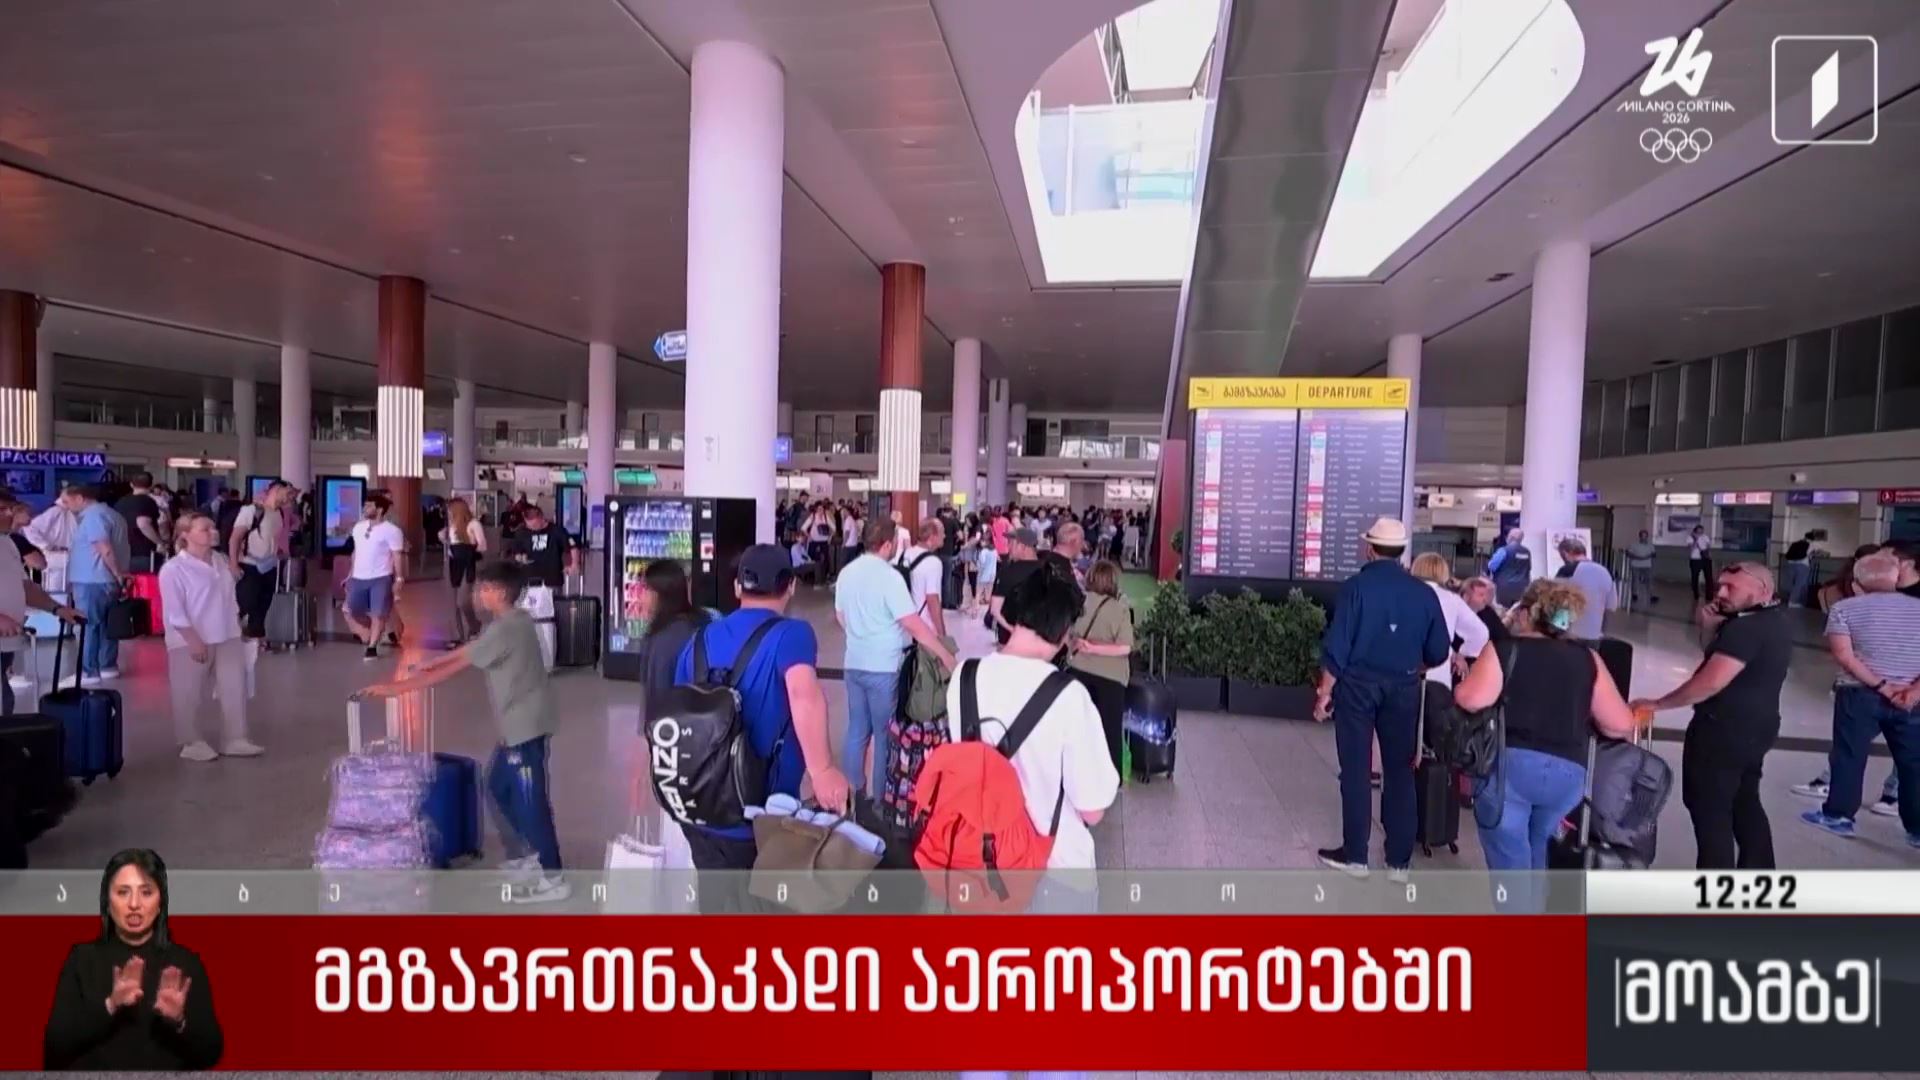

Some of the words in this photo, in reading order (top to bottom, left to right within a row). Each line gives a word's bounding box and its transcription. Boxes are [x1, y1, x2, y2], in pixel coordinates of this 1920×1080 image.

[1308, 385, 1373, 399] DEPARTURE
[0, 451, 80, 465] PACKING
[652, 717, 695, 825] KENZO
[679, 727, 707, 825] PARIS
